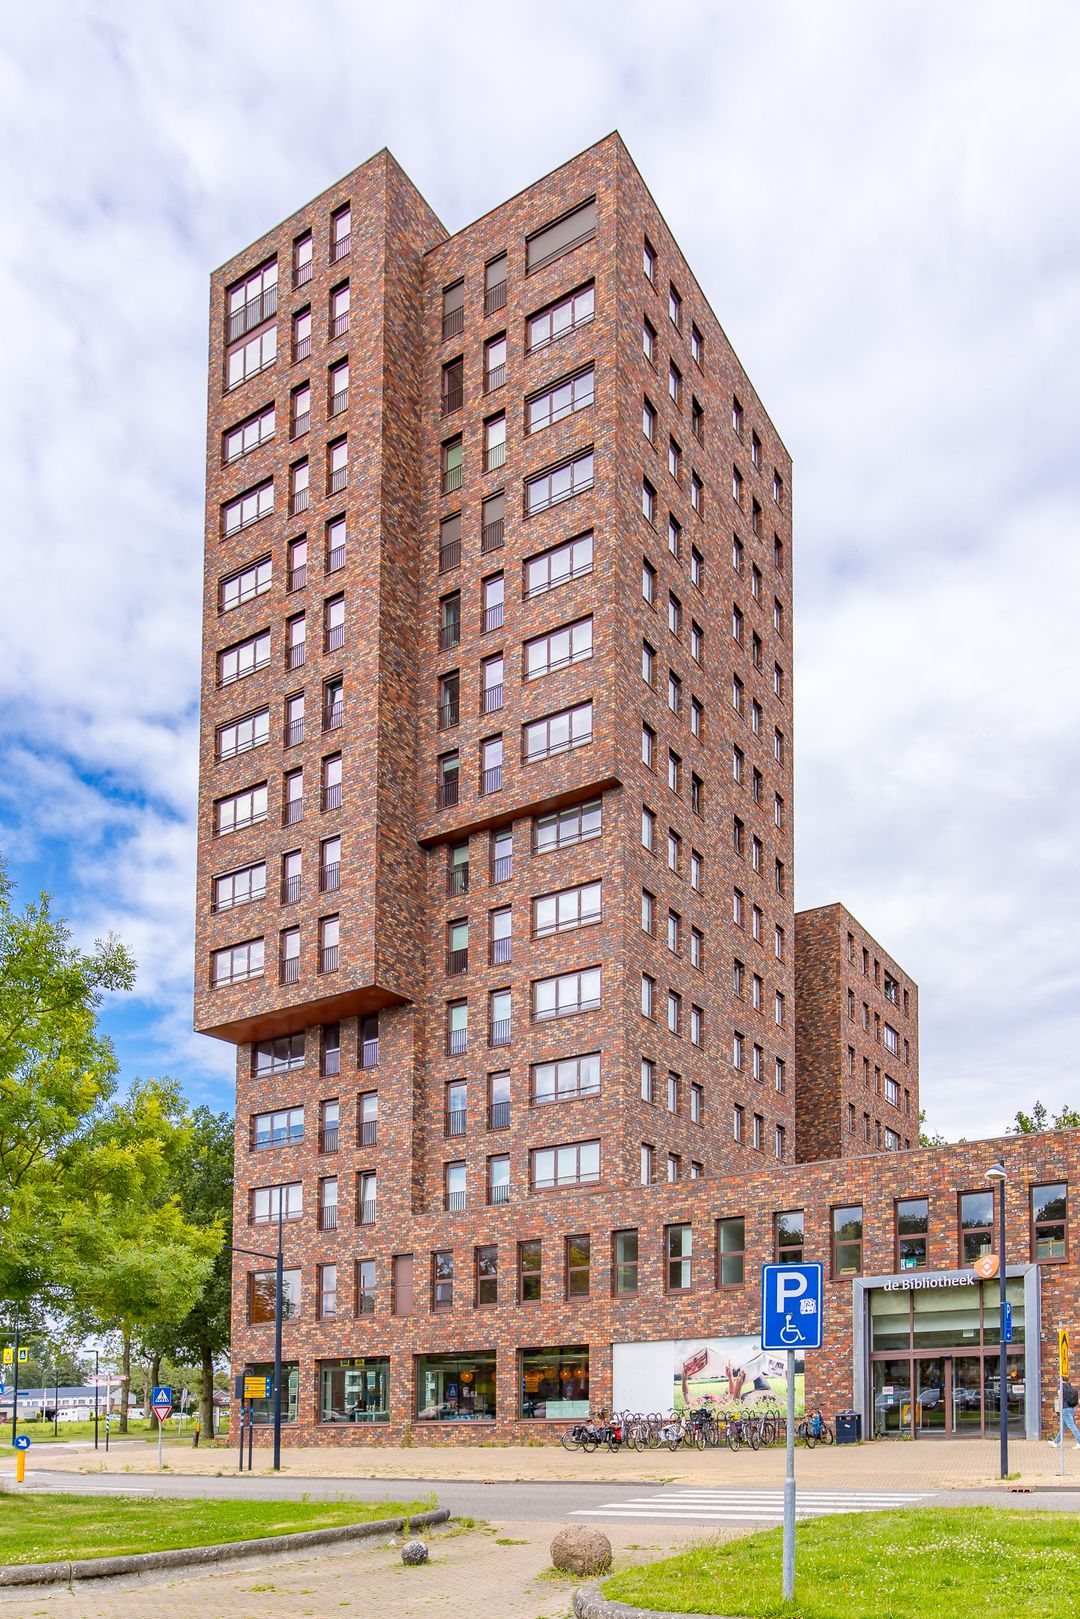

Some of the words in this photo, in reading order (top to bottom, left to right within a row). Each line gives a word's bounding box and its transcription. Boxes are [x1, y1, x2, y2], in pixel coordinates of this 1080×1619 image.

[883, 1280, 899, 1291] de
[902, 1274, 974, 1290] Bibliotheek
[777, 1272, 807, 1312] P
[1006, 1304, 1011, 1319] P
